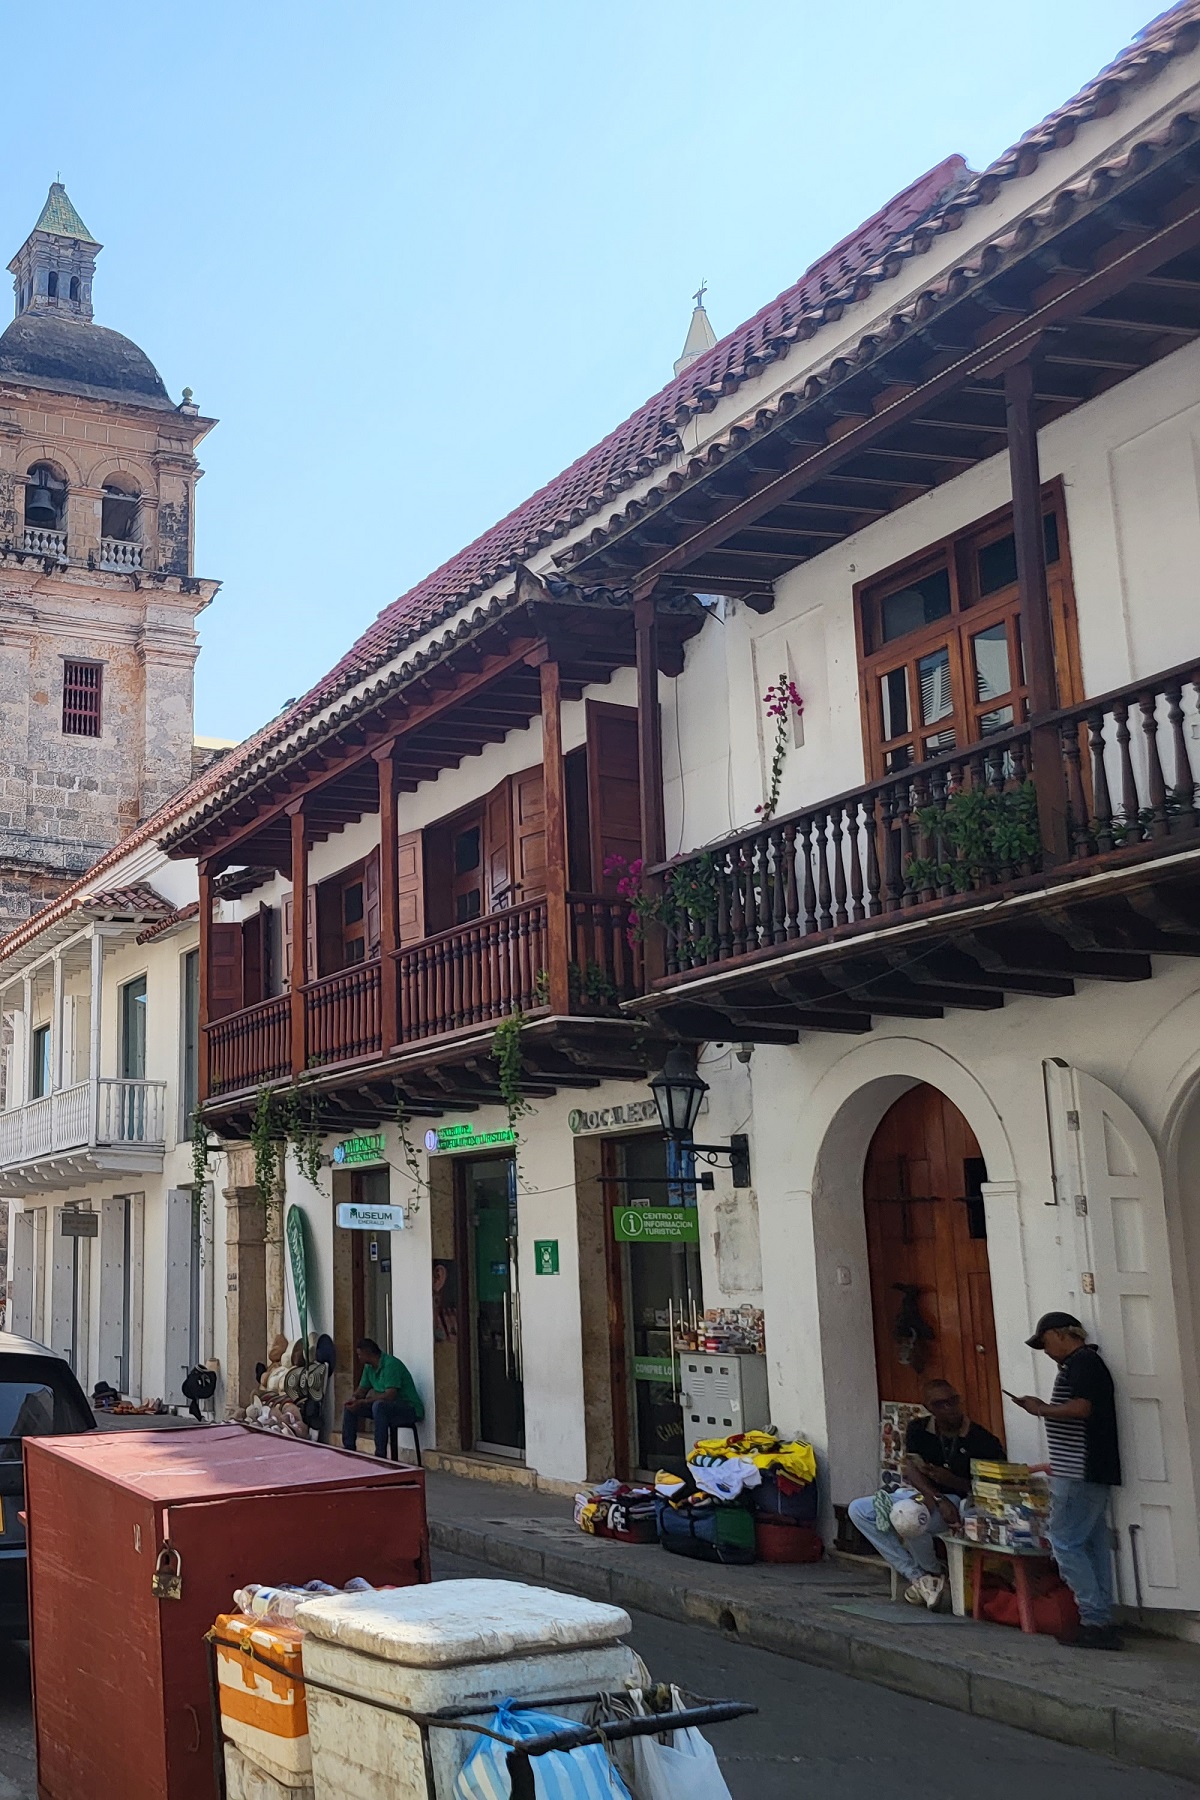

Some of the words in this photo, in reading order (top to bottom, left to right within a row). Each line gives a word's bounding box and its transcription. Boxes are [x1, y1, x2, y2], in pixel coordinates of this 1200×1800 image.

[350, 1209, 393, 1221] MUSEUM
[643, 1212, 672, 1220] CENTRO
[643, 1220, 693, 1229] INFORMACION
[644, 1227, 682, 1236] TURISTICA
